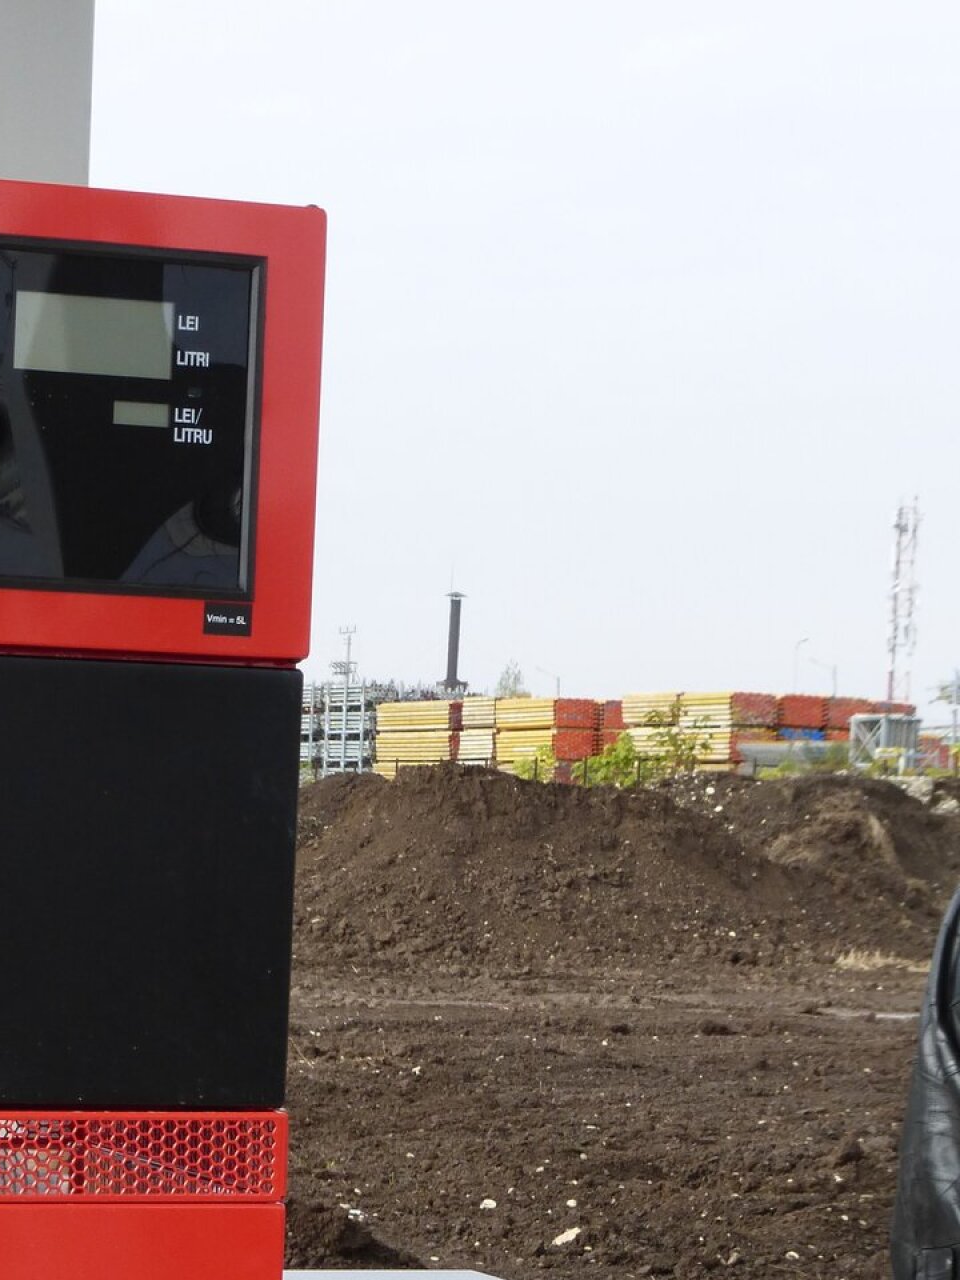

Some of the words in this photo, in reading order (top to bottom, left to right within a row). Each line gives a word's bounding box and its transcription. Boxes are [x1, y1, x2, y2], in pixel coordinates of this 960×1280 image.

[178, 315, 200, 331] LEI
[176, 350, 210, 367] LITRI
[174, 408, 203, 425] LEI/
[173, 427, 213, 445] LITRU
[206, 613, 227, 624] Vmin
